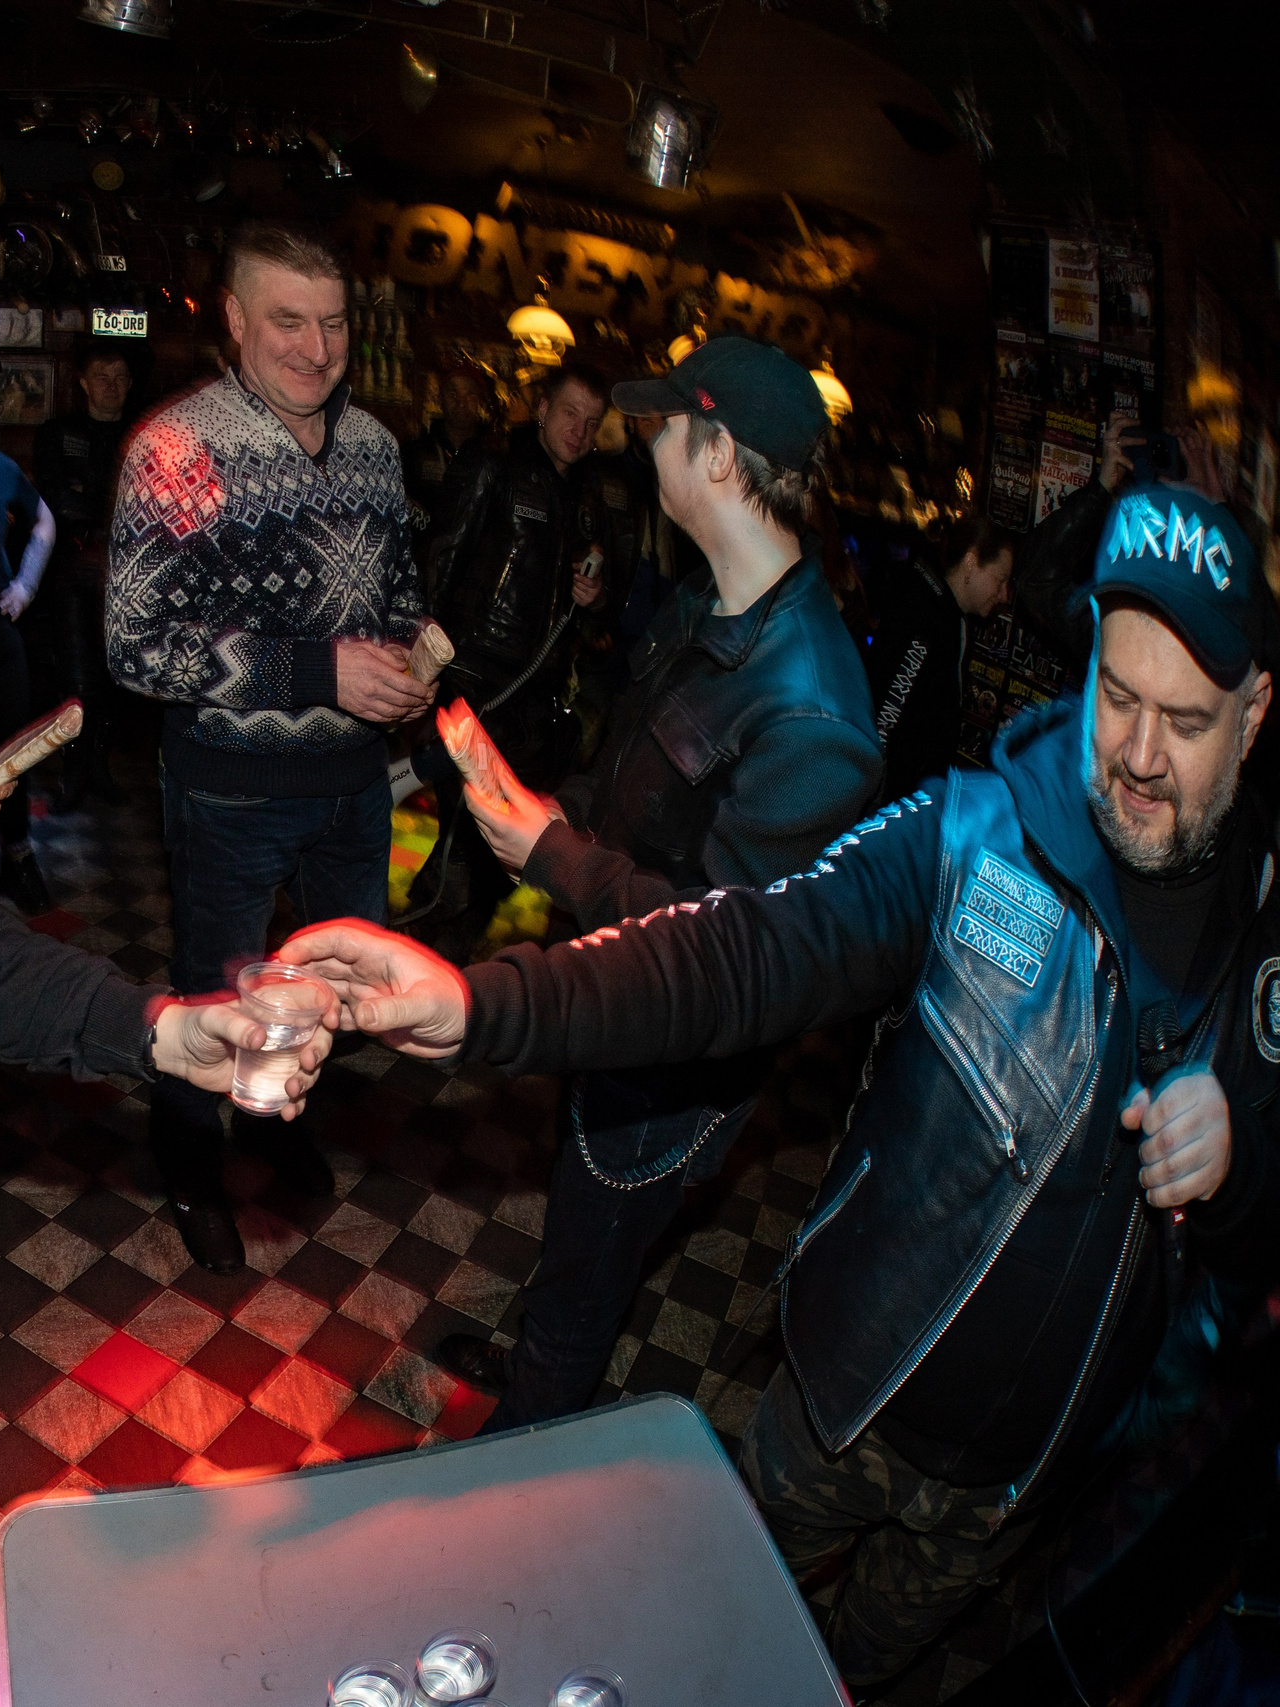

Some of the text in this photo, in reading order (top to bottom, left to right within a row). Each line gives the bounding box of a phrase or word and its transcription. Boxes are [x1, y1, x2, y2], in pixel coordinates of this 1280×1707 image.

[888, 640, 928, 705] SUPPORT
[981, 862, 1061, 924] NORMANS RIDERS
[965, 922, 1034, 977] PROSPECT
